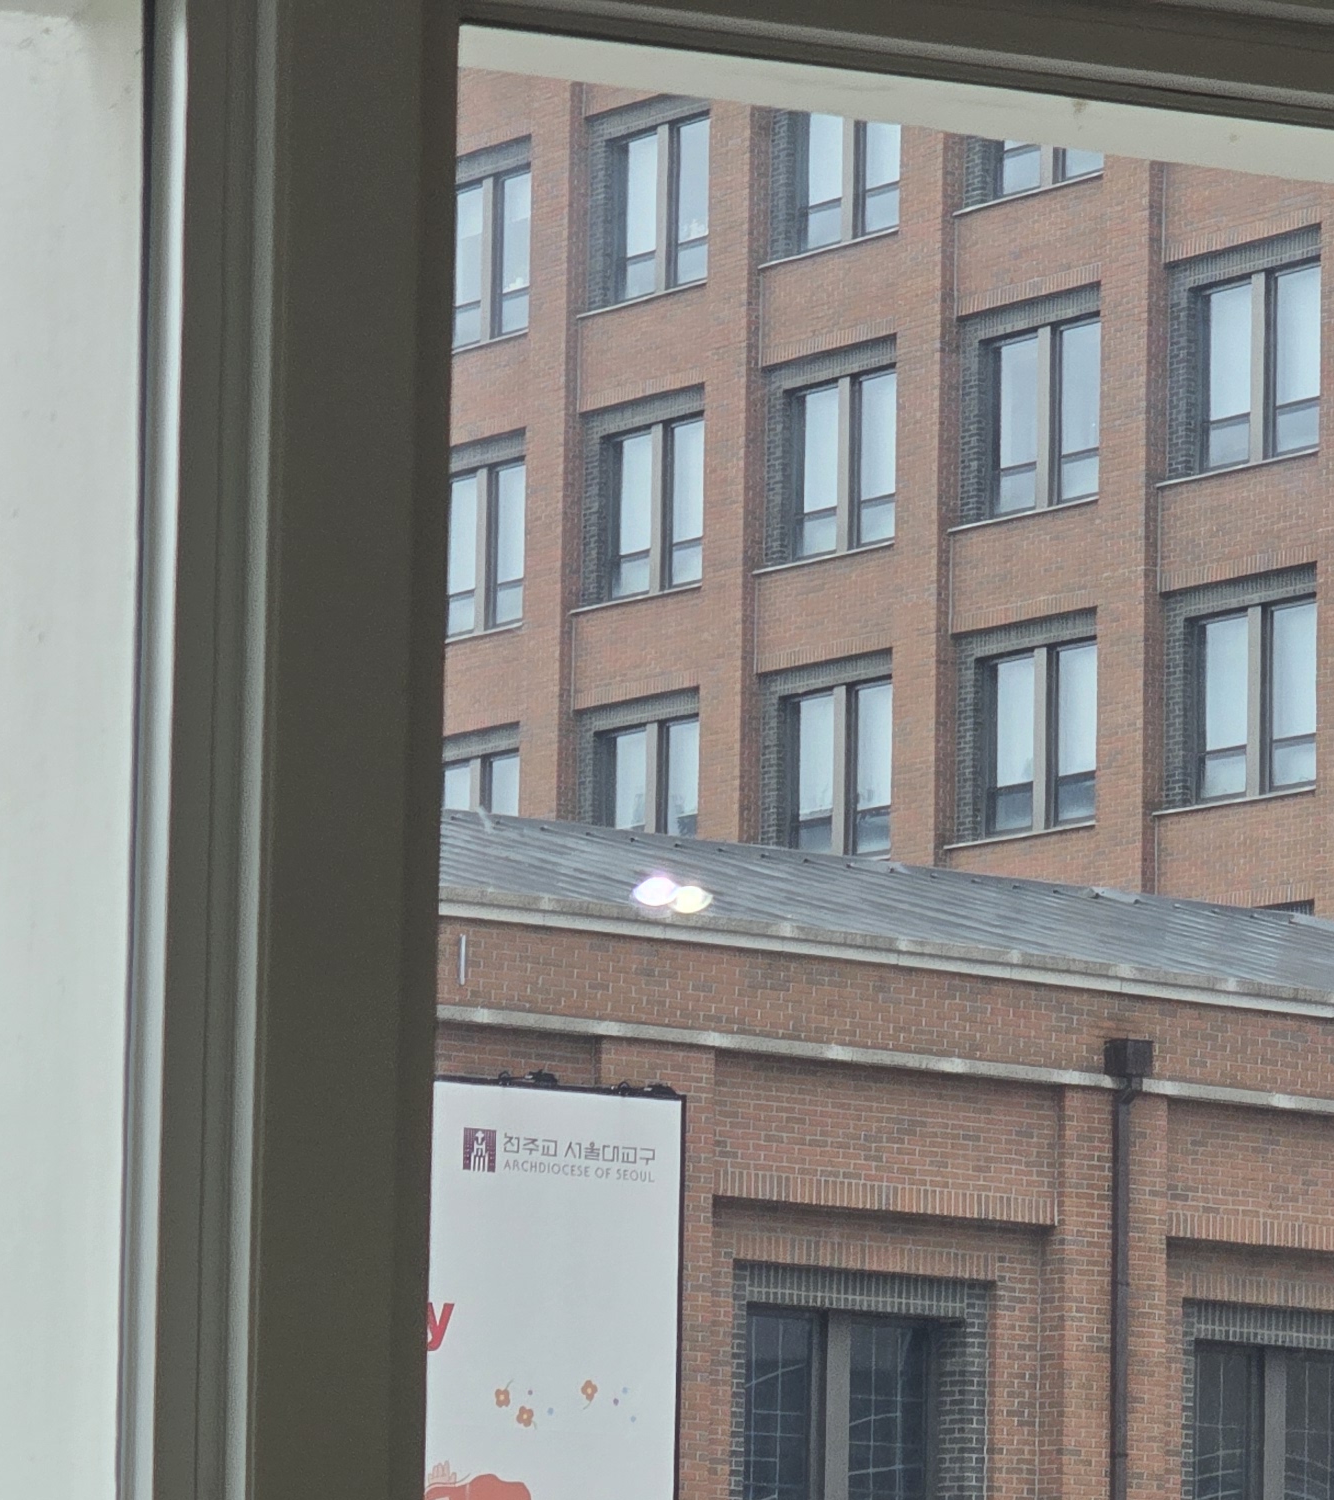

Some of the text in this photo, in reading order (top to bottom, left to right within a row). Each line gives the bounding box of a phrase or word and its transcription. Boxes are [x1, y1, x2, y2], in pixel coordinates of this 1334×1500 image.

[503, 1132, 656, 1167] 천주교 서울대교구
[503, 1158, 656, 1183] ARCHDIOCESE OF SEOUL
